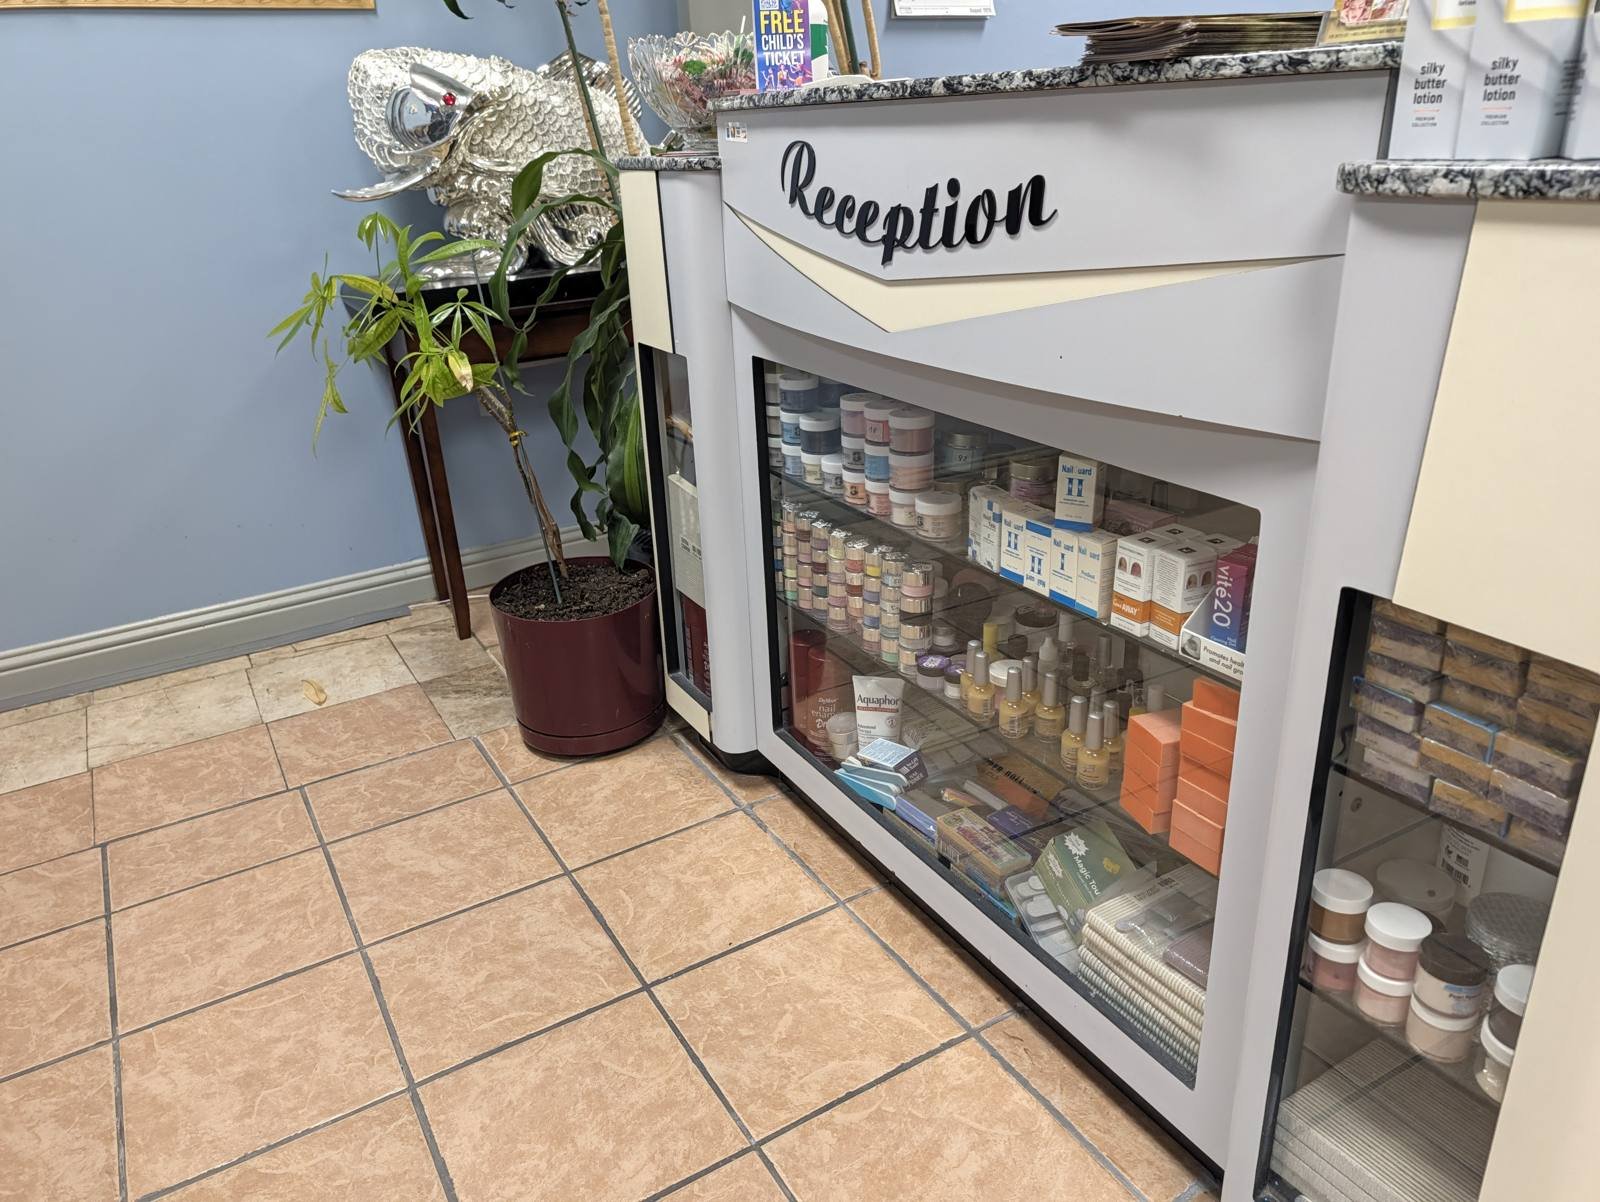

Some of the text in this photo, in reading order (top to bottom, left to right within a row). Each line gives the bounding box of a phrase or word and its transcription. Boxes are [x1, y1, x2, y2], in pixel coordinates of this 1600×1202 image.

[760, 10, 804, 34] FREE
[761, 34, 804, 51] CHILD'S
[763, 50, 806, 66] TICKET
[1491, 57, 1519, 72] silky
[1420, 62, 1445, 76] silky
[1414, 77, 1447, 90] butter
[1483, 72, 1521, 86] butter
[1412, 92, 1443, 105] lotion
[1482, 87, 1516, 102] lotion
[780, 140, 1058, 266] Reception
[1061, 464, 1073, 474] Nail
[1203, 645, 1229, 661] Promotes
[1209, 657, 1220, 665] and
[1221, 662, 1233, 670] nail
[857, 694, 900, 707] Aquaphor
[1073, 855, 1091, 882] Magic
